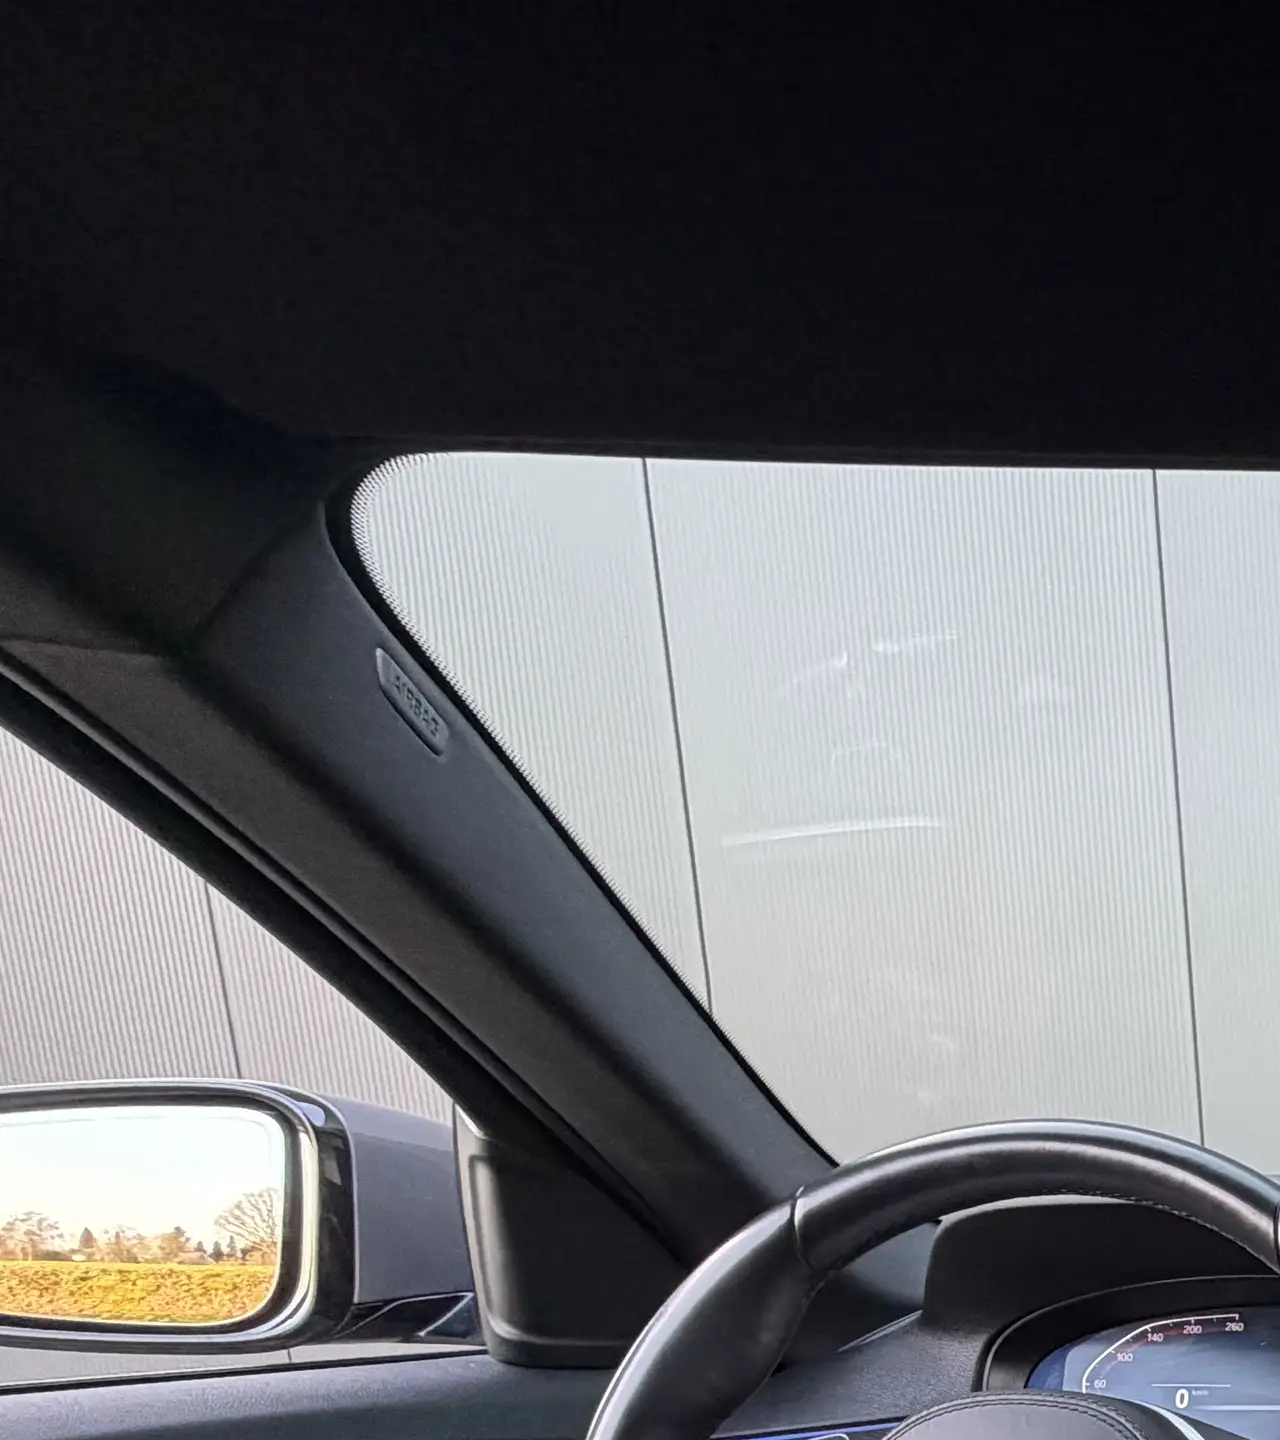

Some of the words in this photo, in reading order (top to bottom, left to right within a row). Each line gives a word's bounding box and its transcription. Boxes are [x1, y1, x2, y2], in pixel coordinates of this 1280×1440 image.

[1183, 1325, 1202, 1335] 200
[1225, 1322, 1244, 1332] 260
[1147, 1333, 1164, 1342] 140
[1117, 1353, 1133, 1362] 100
[1094, 1379, 1106, 1388] 60
[1175, 1389, 1189, 1409] 0
